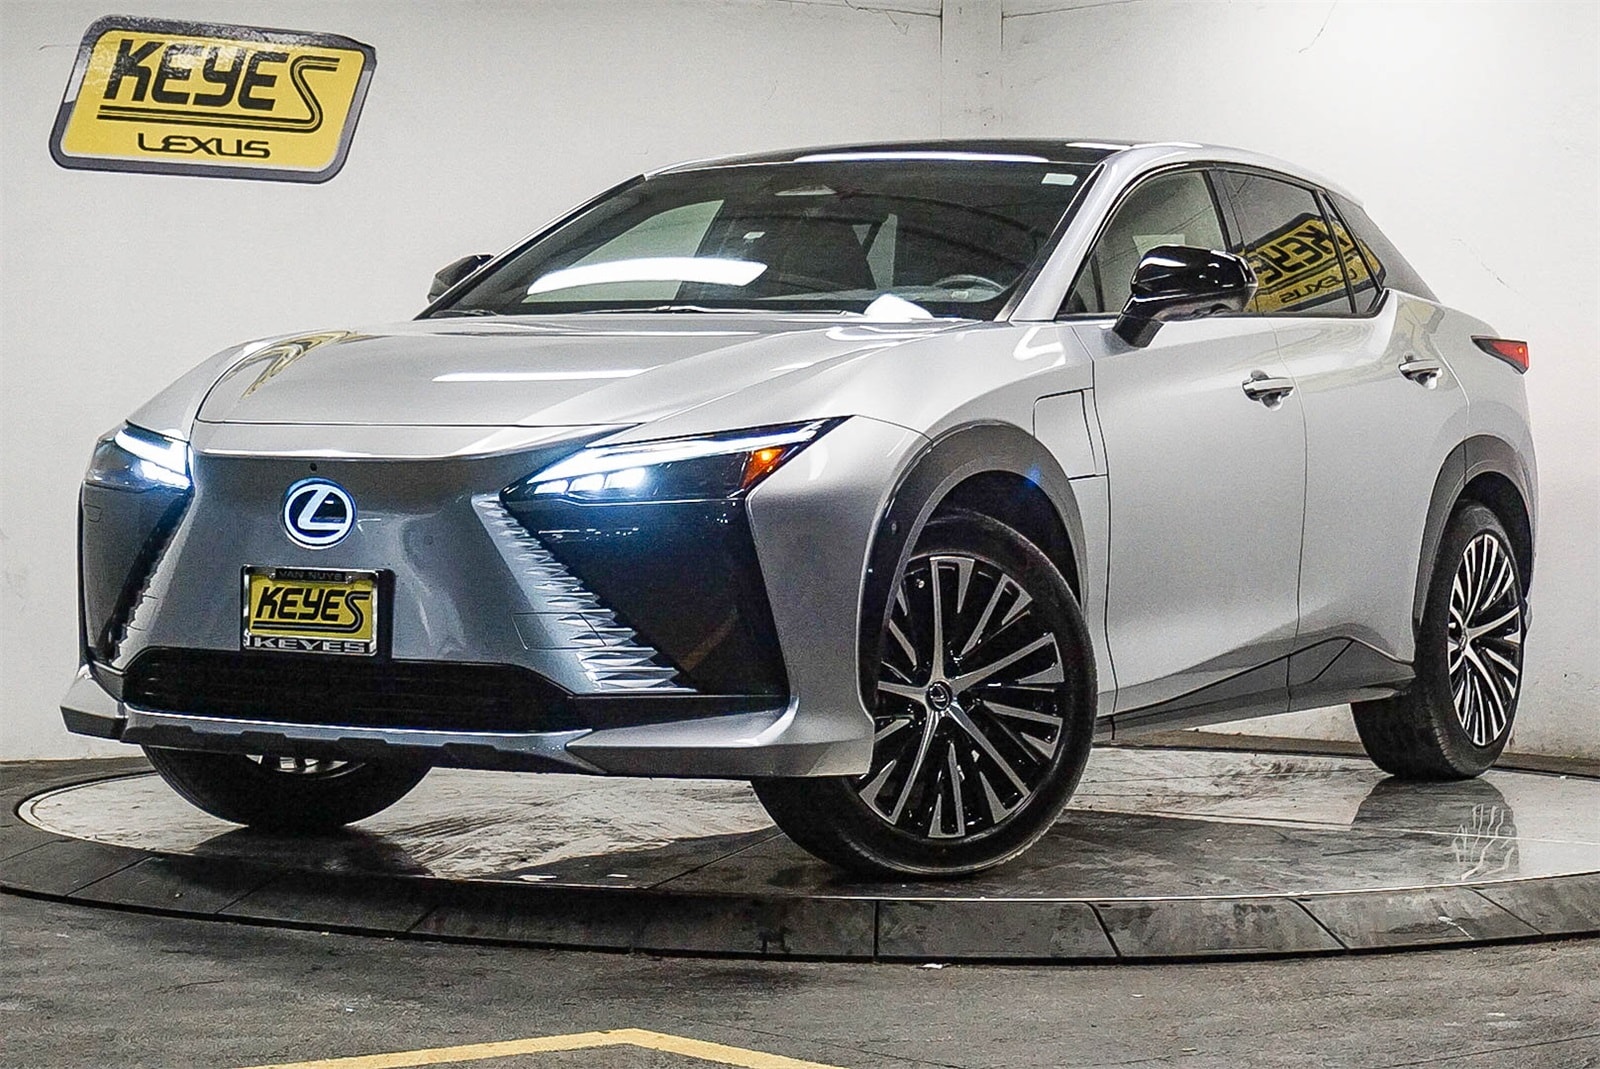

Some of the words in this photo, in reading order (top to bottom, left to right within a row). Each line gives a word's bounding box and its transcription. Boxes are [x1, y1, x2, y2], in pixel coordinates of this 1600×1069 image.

[97, 39, 340, 133] KEYES
[137, 132, 271, 158] LEXUS
[278, 570, 305, 579] VAN
[309, 571, 343, 580] NUYS
[251, 586, 373, 634] KEYES
[254, 637, 366, 653] KEYES
